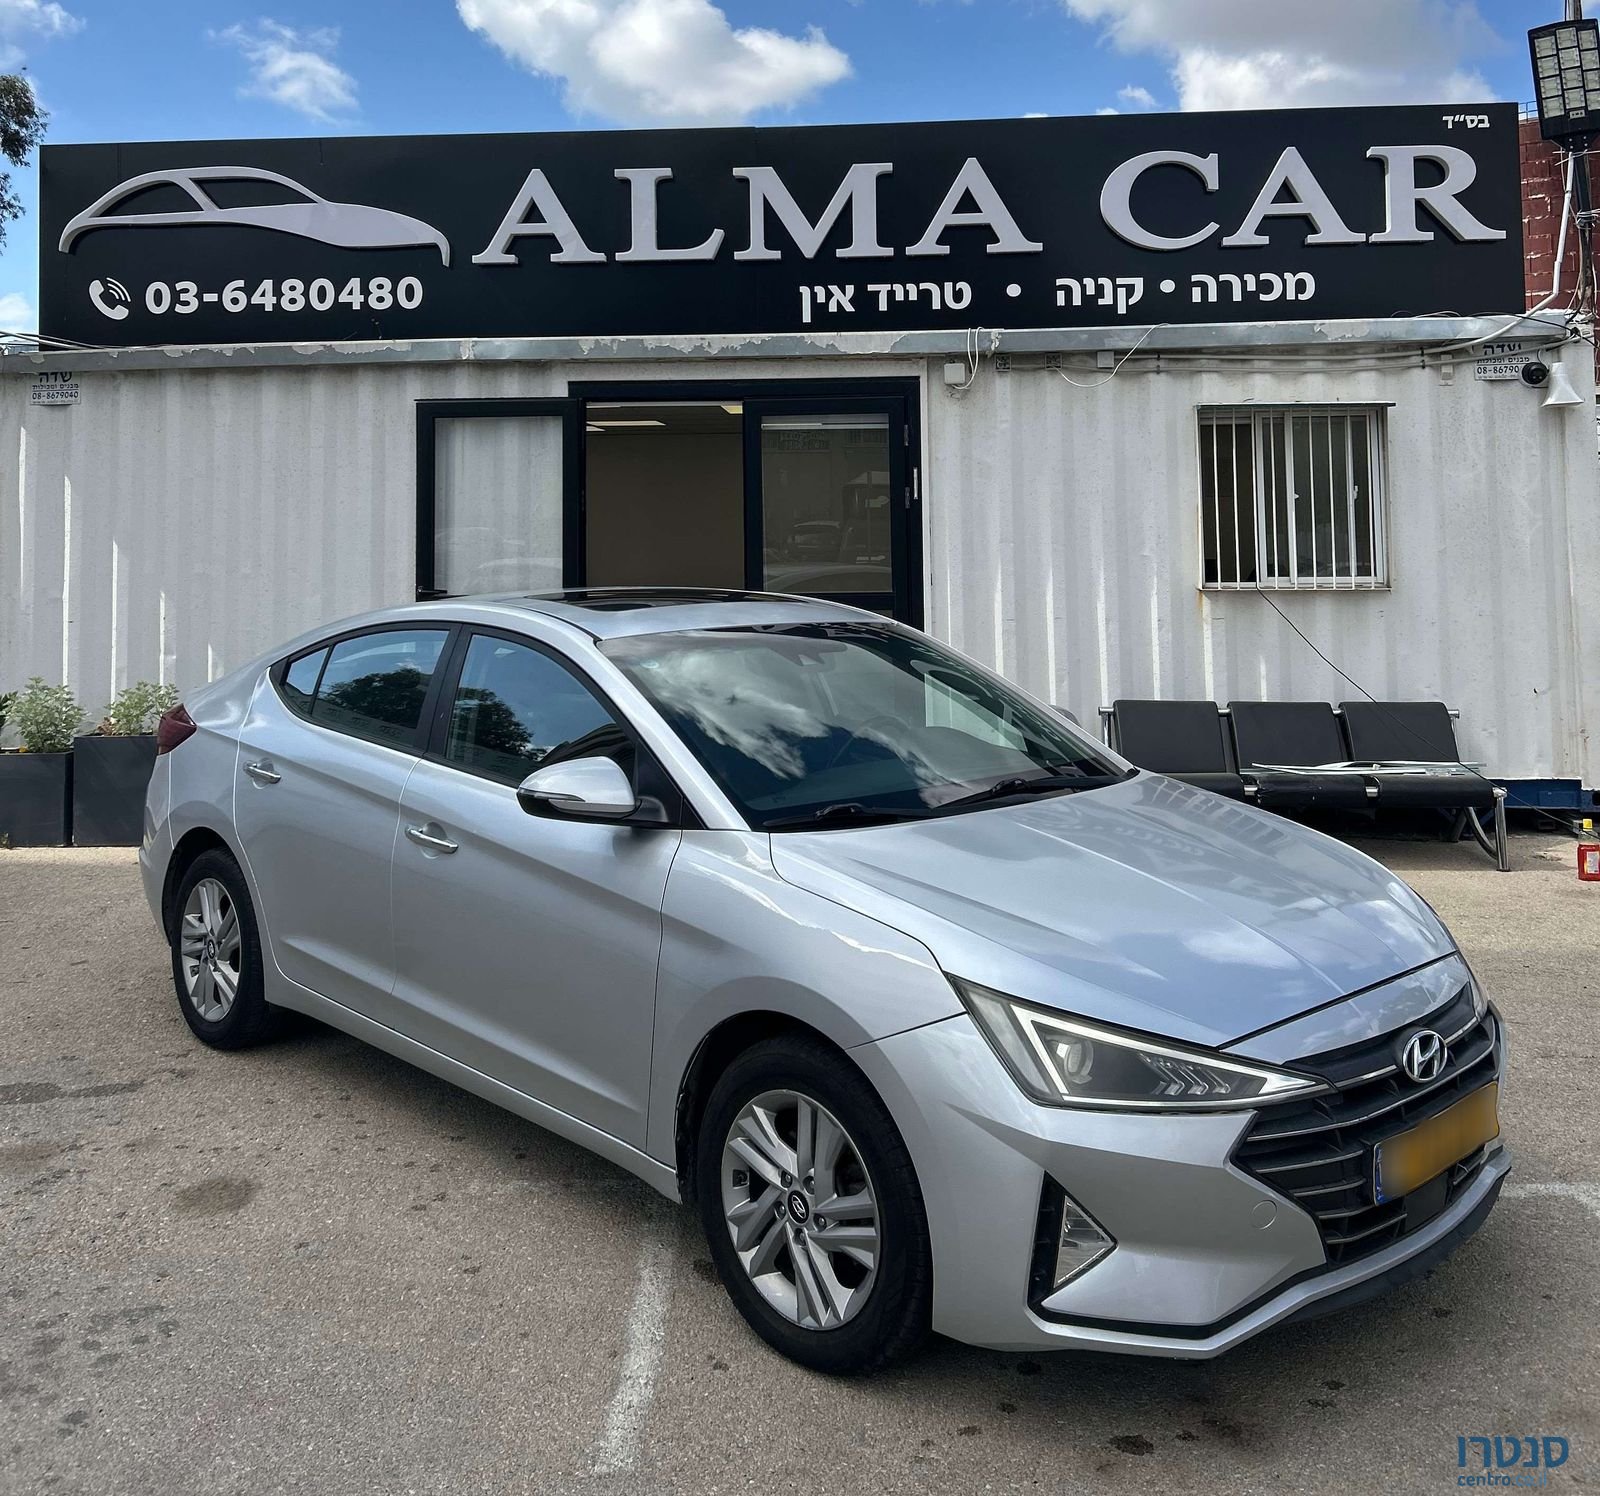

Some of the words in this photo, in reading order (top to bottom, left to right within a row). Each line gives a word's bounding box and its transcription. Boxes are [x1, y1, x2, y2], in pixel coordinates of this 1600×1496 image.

[472, 158, 1044, 264] ALMA
[1099, 144, 1507, 250] CAR
[145, 277, 423, 315] 03-6480480
[799, 283, 856, 323] אין
[867, 281, 972, 312] טרייד
[1056, 277, 1144, 315] קניה
[1190, 271, 1316, 303] מכירה
[1477, 365, 1520, 375] 08-86790
[32, 391, 79, 400] 08-8679040
